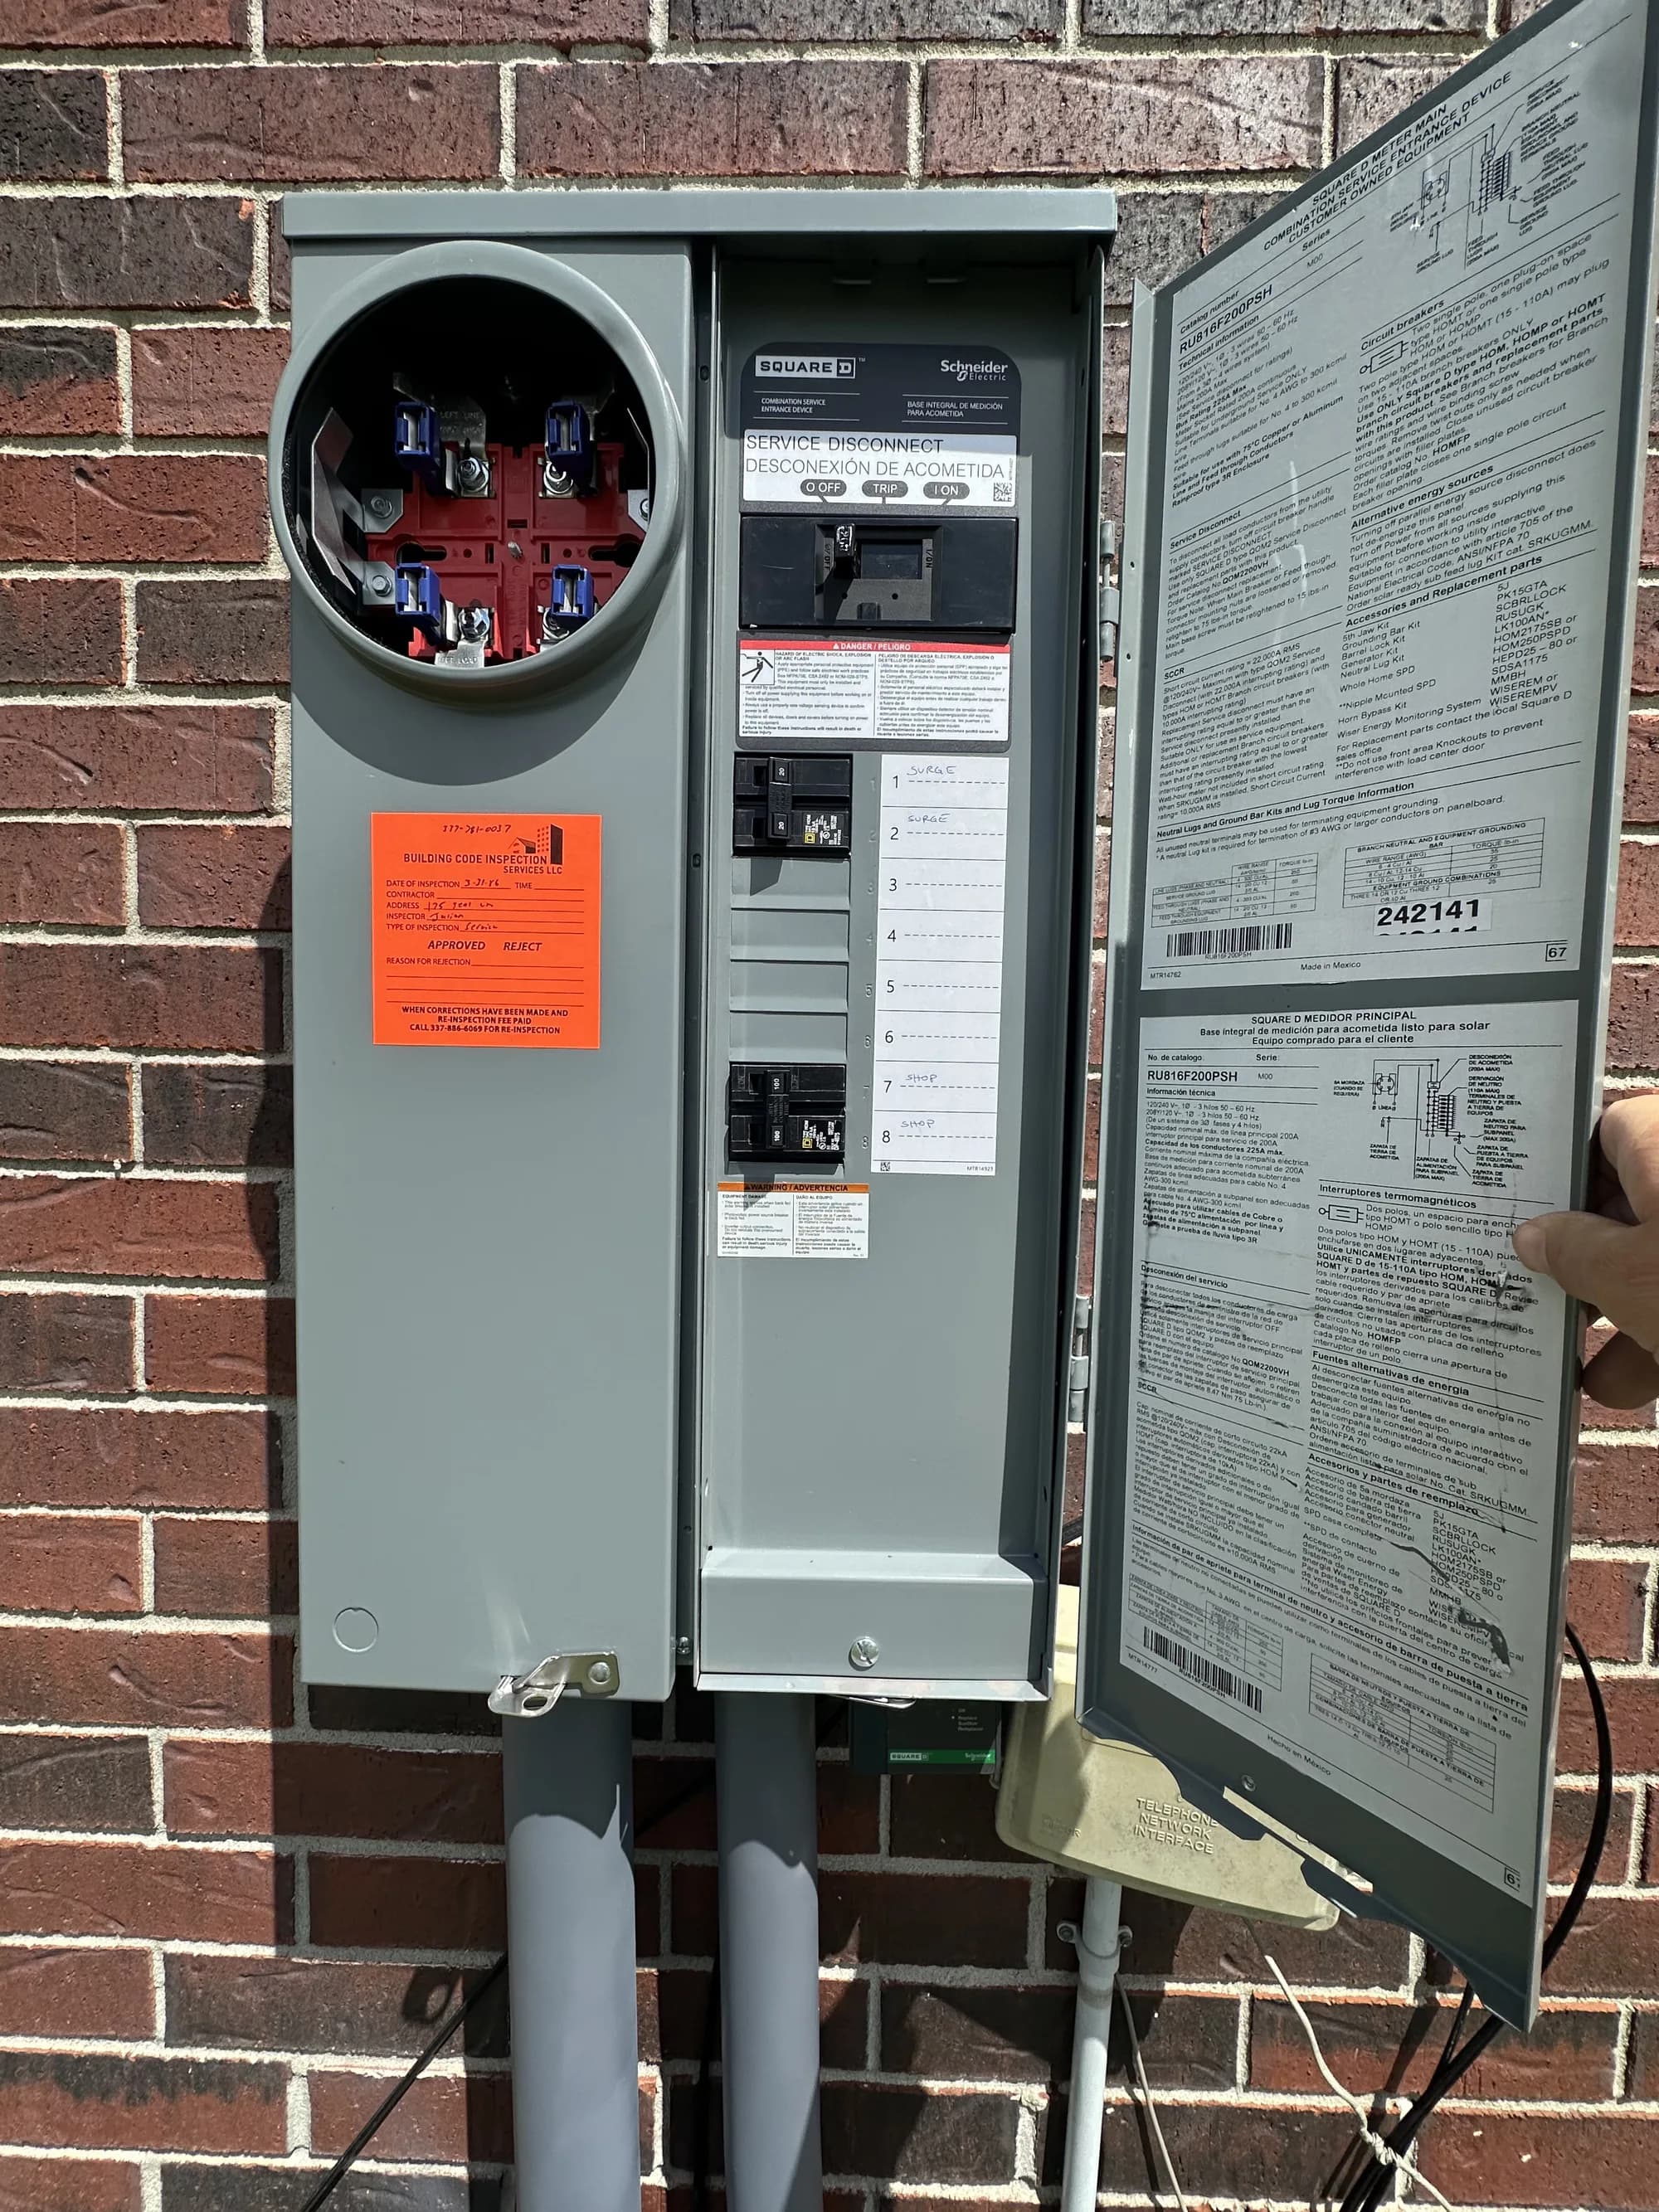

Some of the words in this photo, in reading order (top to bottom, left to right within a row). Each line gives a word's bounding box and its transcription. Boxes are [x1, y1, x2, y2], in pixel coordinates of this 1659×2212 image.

[1264, 195, 1335, 250] COMBINATION
[1339, 160, 1387, 201] SERVICE
[1390, 112, 1457, 163] ENTRANCE
[1462, 71, 1512, 113] DEVICE
[1313, 169, 1358, 206] SQUARE
[1361, 159, 1370, 172] D
[1372, 131, 1412, 163] METER
[1416, 105, 1447, 134] MAIN
[1289, 198, 1347, 244] CUSTOMER
[1350, 167, 1393, 202] OWNED
[1397, 113, 1469, 168] EQUIPMENT
[1302, 229, 1330, 251] Series
[1180, 284, 1272, 355] RU816F200PSH
[1361, 324, 1394, 351] Circuit
[1397, 300, 1445, 332] breakers
[1179, 336, 1214, 371] Technical
[1215, 315, 1259, 349] information
[761, 361, 833, 372] SQUARE
[941, 360, 1008, 374] Schneider
[970, 401, 1003, 410] MEDICIÓN
[747, 435, 820, 450] SERVICE
[830, 437, 943, 454] DISCONNECT
[747, 457, 870, 475] DESCONEXIÓN
[877, 461, 898, 476] DE
[903, 462, 1004, 478] ACOMETIDA
[819, 483, 840, 493] OFF
[873, 484, 898, 493] TRIP
[941, 485, 958, 496] ON
[1345, 600, 1408, 628] Accessories
[1410, 593, 1429, 606] and
[1433, 566, 1508, 599] Replacement
[1510, 555, 1543, 578] parts
[1497, 580, 1548, 602] PK15GTA
[1496, 584, 1567, 613] SCBRLLOCK
[1496, 602, 1545, 624] RUSUGK
[878, 643, 911, 651] PELIGRO
[779, 768, 785, 776] 20
[907, 766, 956, 775] SURGE
[893, 775, 898, 788] 1
[1156, 825, 1183, 839] Neutral
[1184, 822, 1202, 836] Lugs
[1203, 819, 1218, 829] and
[1219, 814, 1248, 827] Ground
[1250, 810, 1264, 820] Bar
[1267, 807, 1283, 817] Kits
[1285, 804, 1301, 814] and
[1303, 800, 1320, 813] Lug
[1322, 795, 1355, 809] Torque
[1358, 781, 1414, 800] Information
[908, 814, 951, 823] SURGE
[779, 822, 784, 830] 20
[890, 827, 898, 840] 2
[404, 853, 452, 863] BUILDING
[456, 854, 482, 863] CODE
[486, 854, 547, 864] INSPECTION
[504, 866, 544, 874] SERVICES
[889, 878, 898, 892] 3
[1377, 899, 1479, 926] 242141
[888, 930, 897, 942] 4
[428, 941, 485, 950] APPROVED
[504, 941, 542, 951] REJECT
[1549, 946, 1567, 958] 67
[1333, 961, 1361, 970] Mexico
[887, 980, 895, 993] 5
[438, 1016, 497, 1024] RE-INSPECTION
[1252, 1015, 1292, 1024] SQUARE
[1304, 1014, 1352, 1023] MEDIDOR
[1355, 1011, 1417, 1021] PRINCIPAL
[431, 1024, 483, 1033] 337-886-6069
[501, 1026, 560, 1034] RE-INSPECTION
[1223, 1028, 1255, 1037] integral
[1272, 1026, 1314, 1034] medición
[1317, 1026, 1340, 1034] para
[1342, 1024, 1398, 1033] acometida
[1401, 1023, 1424, 1032] listo
[1428, 1023, 1457, 1033] para
[1459, 1021, 1491, 1031] solar
[885, 1030, 893, 1043] 6
[906, 1074, 937, 1083] SHOP
[1148, 1070, 1238, 1082] RU816F200PSH
[883, 1081, 892, 1093] 7
[901, 1119, 935, 1128] SHOP
[882, 1130, 891, 1143] 8
[1320, 1184, 1381, 1198] Interruptores
[1384, 1191, 1477, 1209] termomagnéticos
[1141, 1265, 1185, 1280] Desconexión
[1185, 1274, 1197, 1282] del
[1199, 1277, 1228, 1289] servicio
[1367, 1332, 1401, 1345] HOMFP
[1308, 1453, 1360, 1475] Accesorios
[1362, 1471, 1368, 1480] y
[1370, 1473, 1403, 1491] partes
[1405, 1483, 1419, 1495] de
[1421, 1490, 1478, 1517] reemplazo
[1267, 1733, 1292, 1753] Hecho
[1292, 1748, 1302, 1759] en
[1304, 1754, 1331, 1776] México
[1136, 1797, 1219, 1828] TELEPHONE
[1140, 1812, 1212, 1840] NETWORK
[1134, 1824, 1214, 1855] INTERFACE
